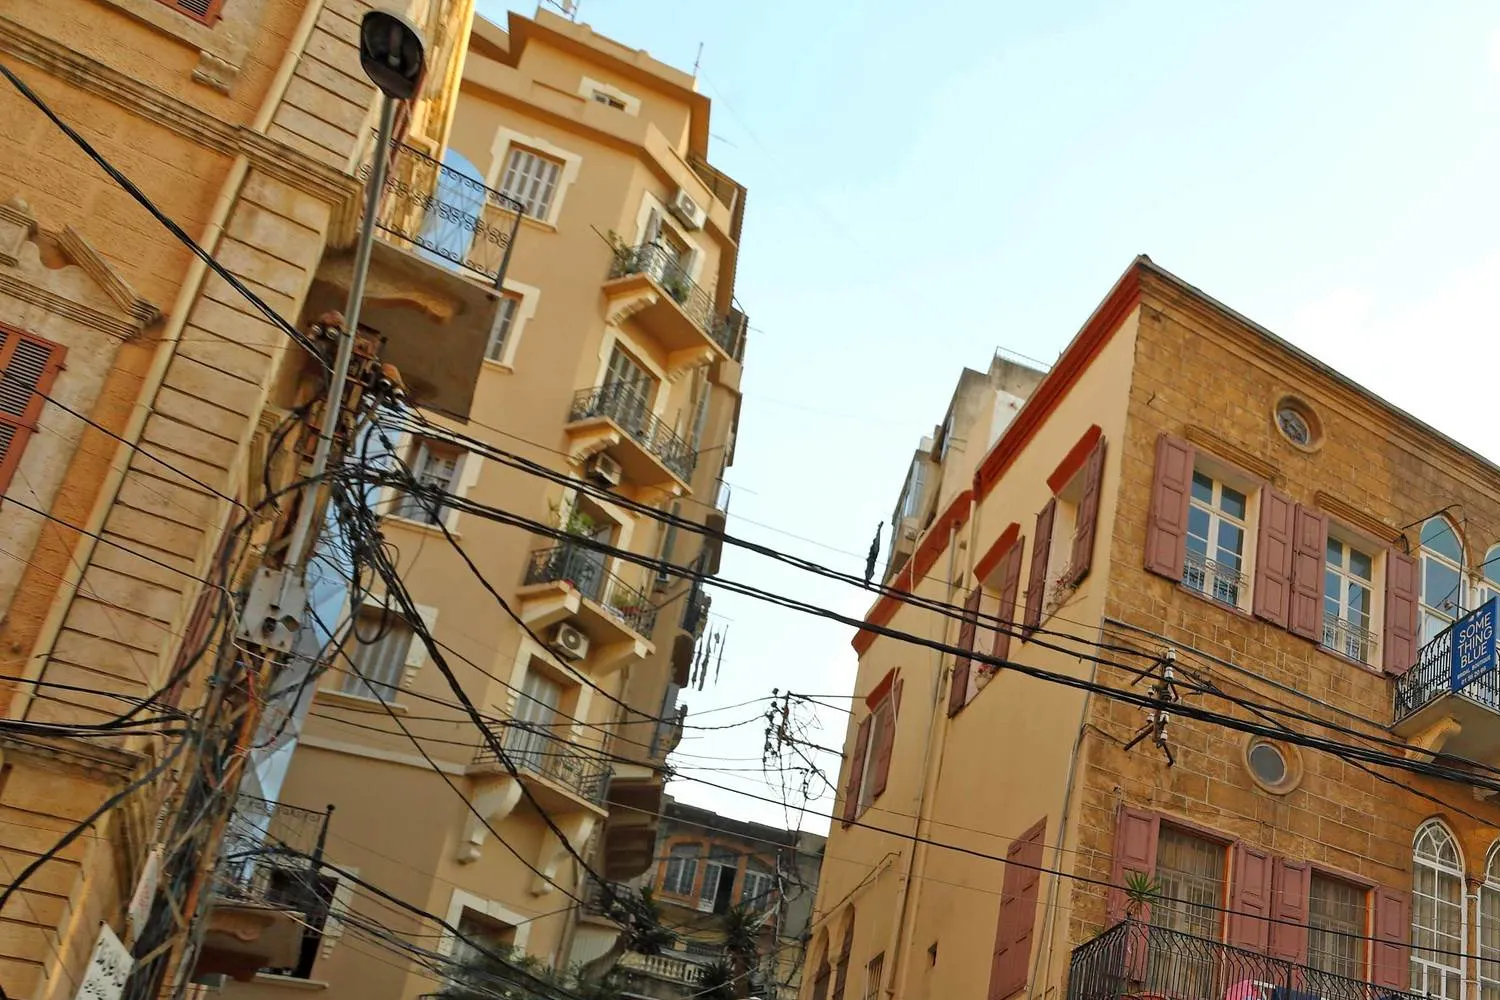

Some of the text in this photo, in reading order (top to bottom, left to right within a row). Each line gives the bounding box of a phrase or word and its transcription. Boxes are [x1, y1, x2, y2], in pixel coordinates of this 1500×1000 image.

[1458, 626, 1493, 657] THING
[1459, 612, 1491, 643] SOME
[1460, 641, 1488, 669] BLUE
